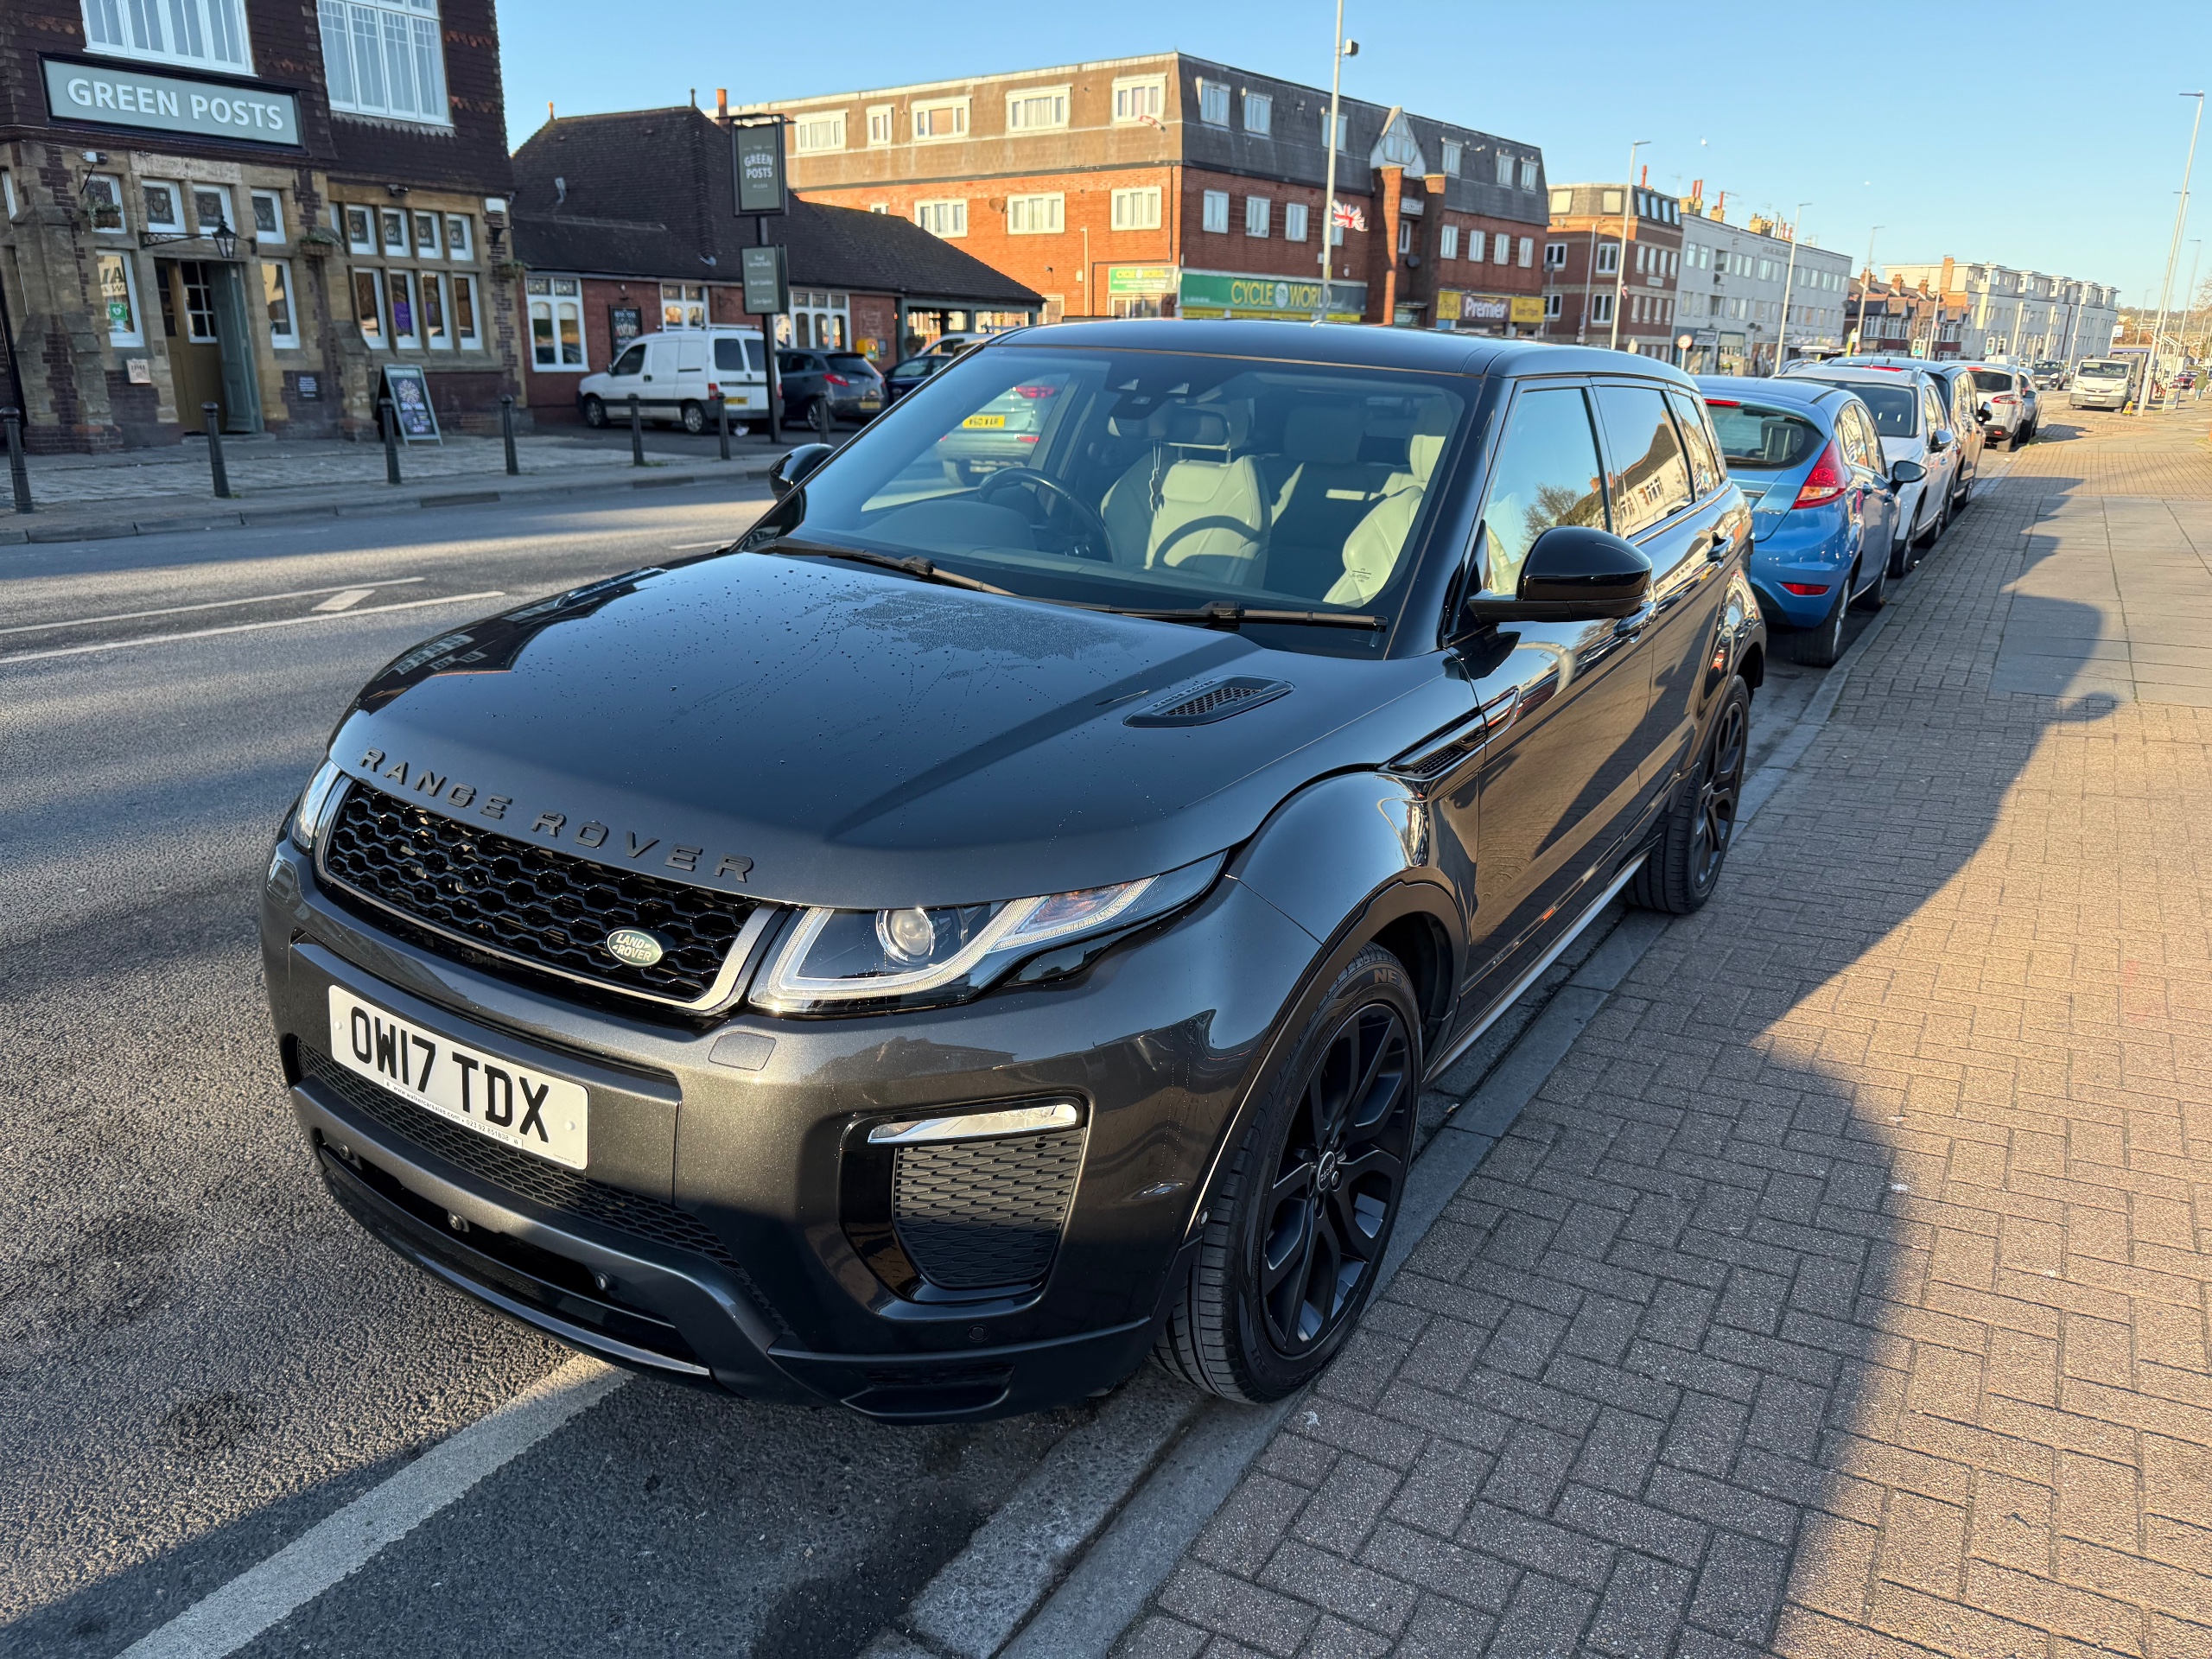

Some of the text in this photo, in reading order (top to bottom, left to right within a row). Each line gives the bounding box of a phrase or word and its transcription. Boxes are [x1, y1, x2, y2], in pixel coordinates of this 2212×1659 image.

[67, 78, 283, 130] GREEN POSTS
[744, 152, 773, 167] GREEN
[746, 167, 773, 179] POSTS
[1230, 281, 1274, 306] CYCLE
[1465, 296, 1506, 318] Premier
[359, 747, 754, 883] RANGE ROVER
[616, 933, 645, 949] LAND
[616, 944, 652, 961] ROVER
[351, 1006, 550, 1144] OW17 TDX
